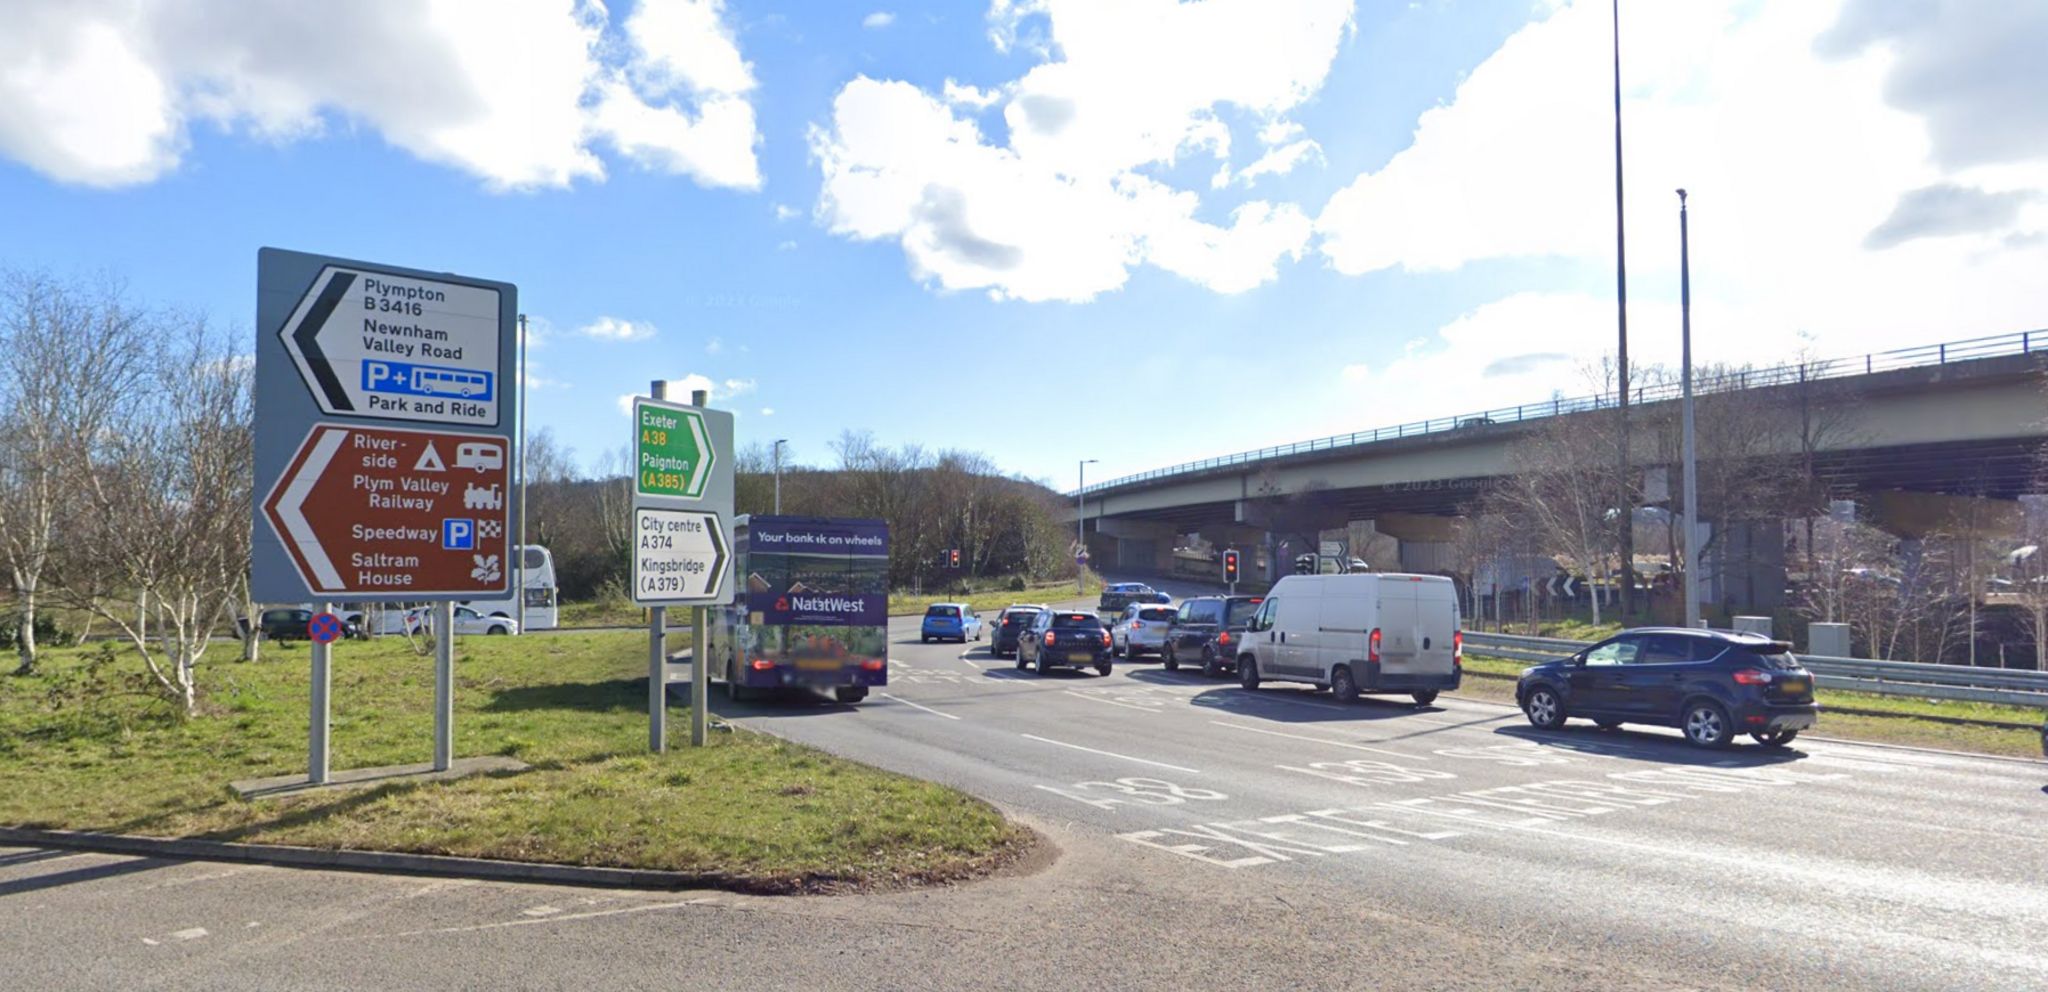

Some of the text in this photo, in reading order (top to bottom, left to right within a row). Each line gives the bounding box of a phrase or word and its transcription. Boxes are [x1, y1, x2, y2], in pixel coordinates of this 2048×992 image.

[365, 279, 444, 302] Plympton
[364, 320, 448, 341] Newnham
[363, 338, 462, 360] Valley Road
[369, 396, 486, 417] Park and Ride
[643, 412, 677, 429] Exeter
[642, 431, 666, 445] A38
[362, 455, 397, 468] side
[643, 453, 689, 471] Paignton
[354, 476, 449, 494] Plym Valley
[642, 471, 685, 490] (A385)
[370, 495, 433, 510] Railway
[642, 517, 701, 532] City centre
[352, 523, 468, 546] Speedway P
[641, 536, 672, 549] A374
[758, 532, 784, 542] Your
[845, 535, 882, 545] wheels
[352, 554, 419, 567] Saltram
[642, 558, 704, 573] Kingsbridge
[359, 572, 412, 585] House
[641, 576, 686, 593] (A379)
